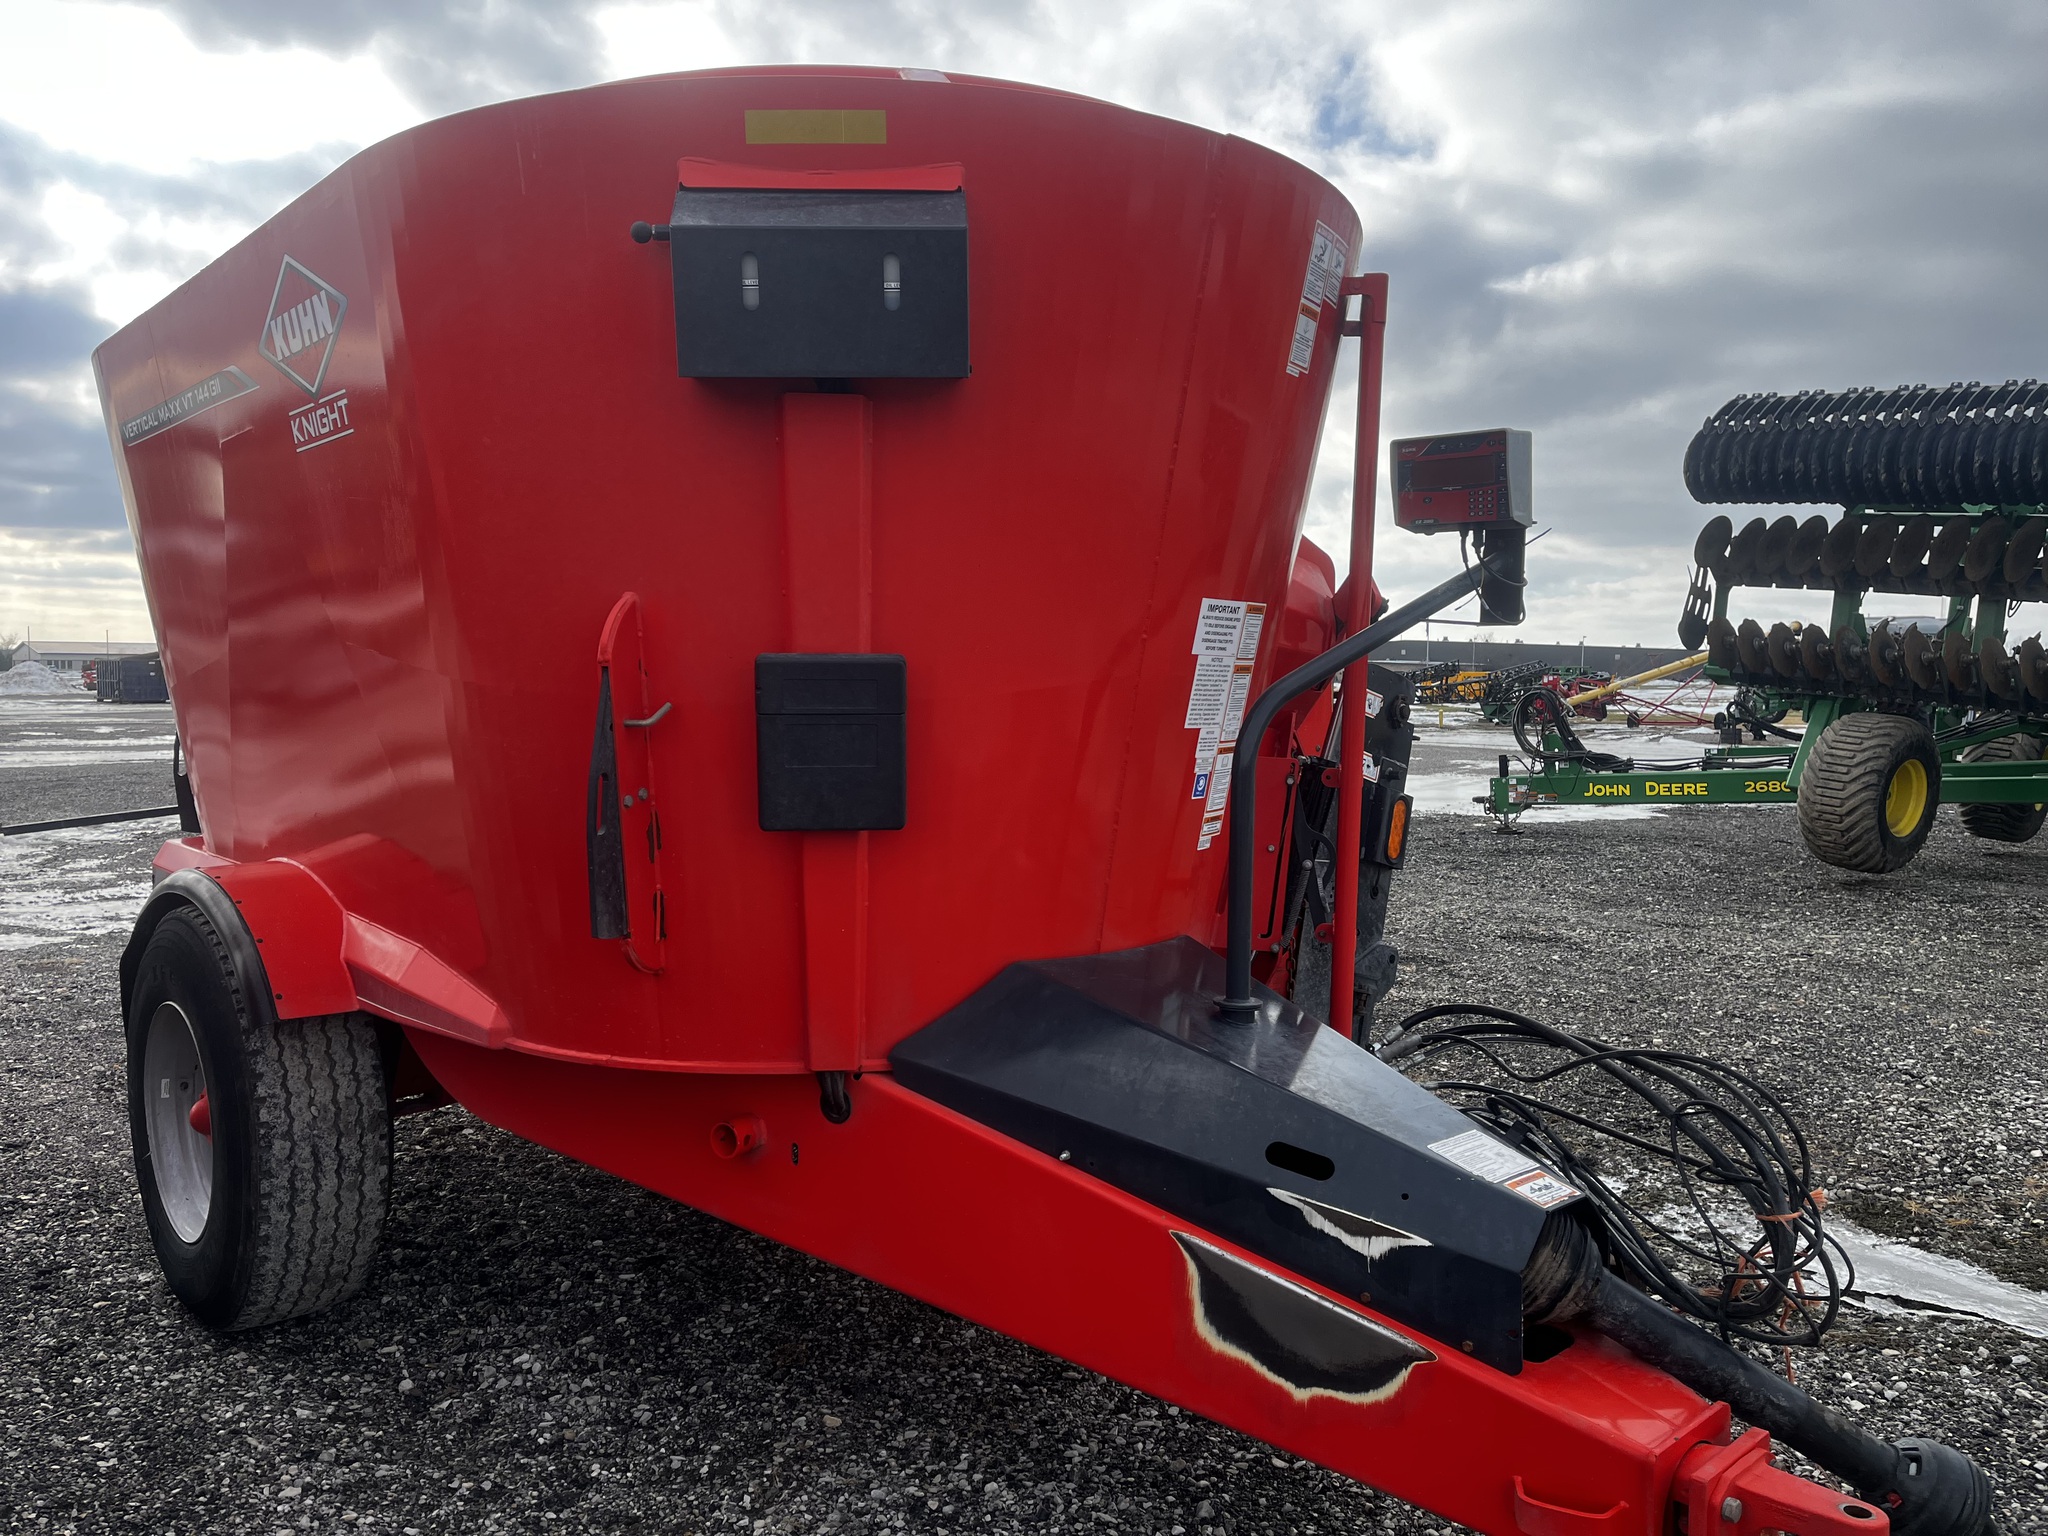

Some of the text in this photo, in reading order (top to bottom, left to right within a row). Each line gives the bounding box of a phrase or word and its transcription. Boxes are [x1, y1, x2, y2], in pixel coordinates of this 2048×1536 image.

[270, 289, 333, 361] KUHN
[123, 413, 158, 438] VERTICAL
[158, 398, 182, 423] MAXX
[182, 392, 193, 411] VT
[195, 382, 210, 403] 144
[290, 398, 348, 444] KNIGHT
[1207, 604, 1240, 615] IMPORTANT
